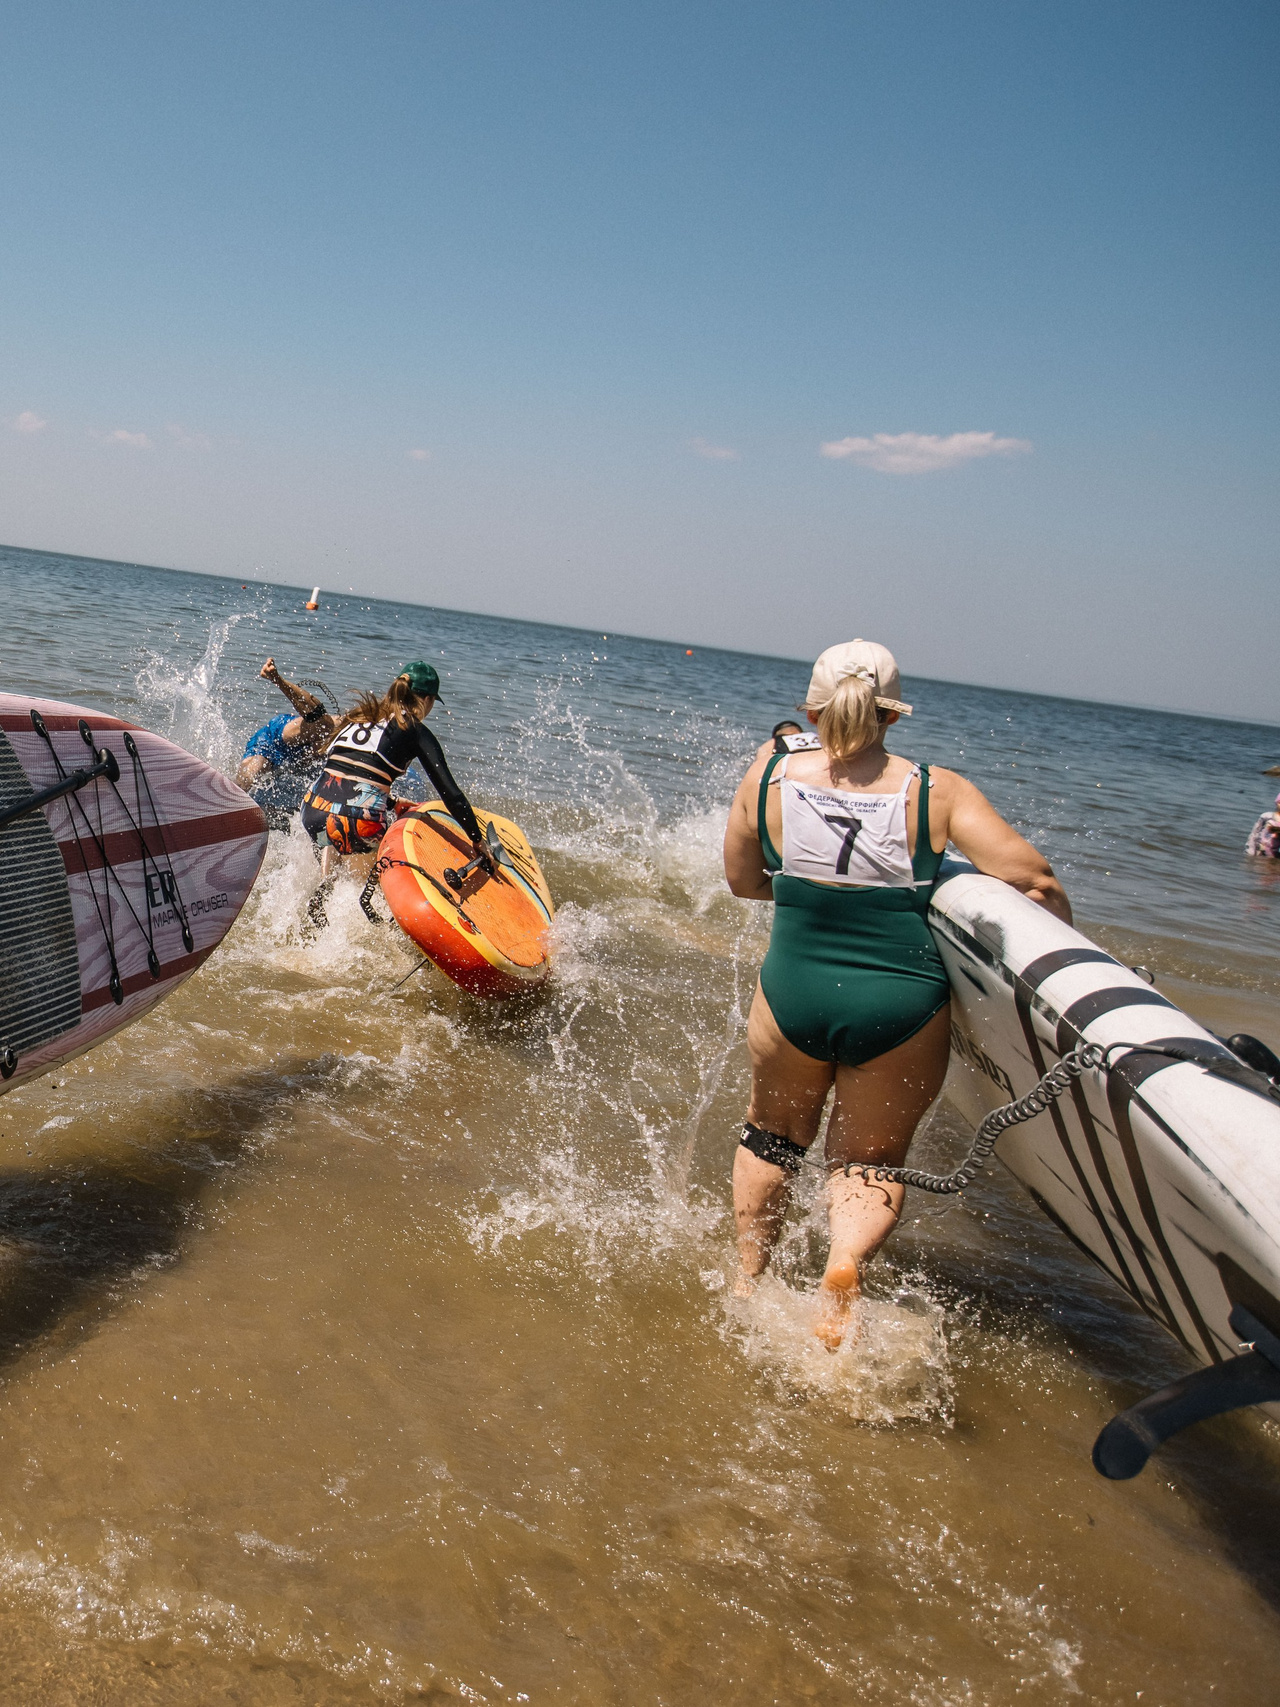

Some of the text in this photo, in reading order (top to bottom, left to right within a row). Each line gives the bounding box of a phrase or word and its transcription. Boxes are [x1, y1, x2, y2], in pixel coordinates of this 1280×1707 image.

[334, 720, 372, 746] 28
[807, 793, 887, 809] ФЕДЕРАЦИЯ СЕРФИНГА
[824, 813, 862, 876] 7
[190, 893, 229, 917] CRUISER
